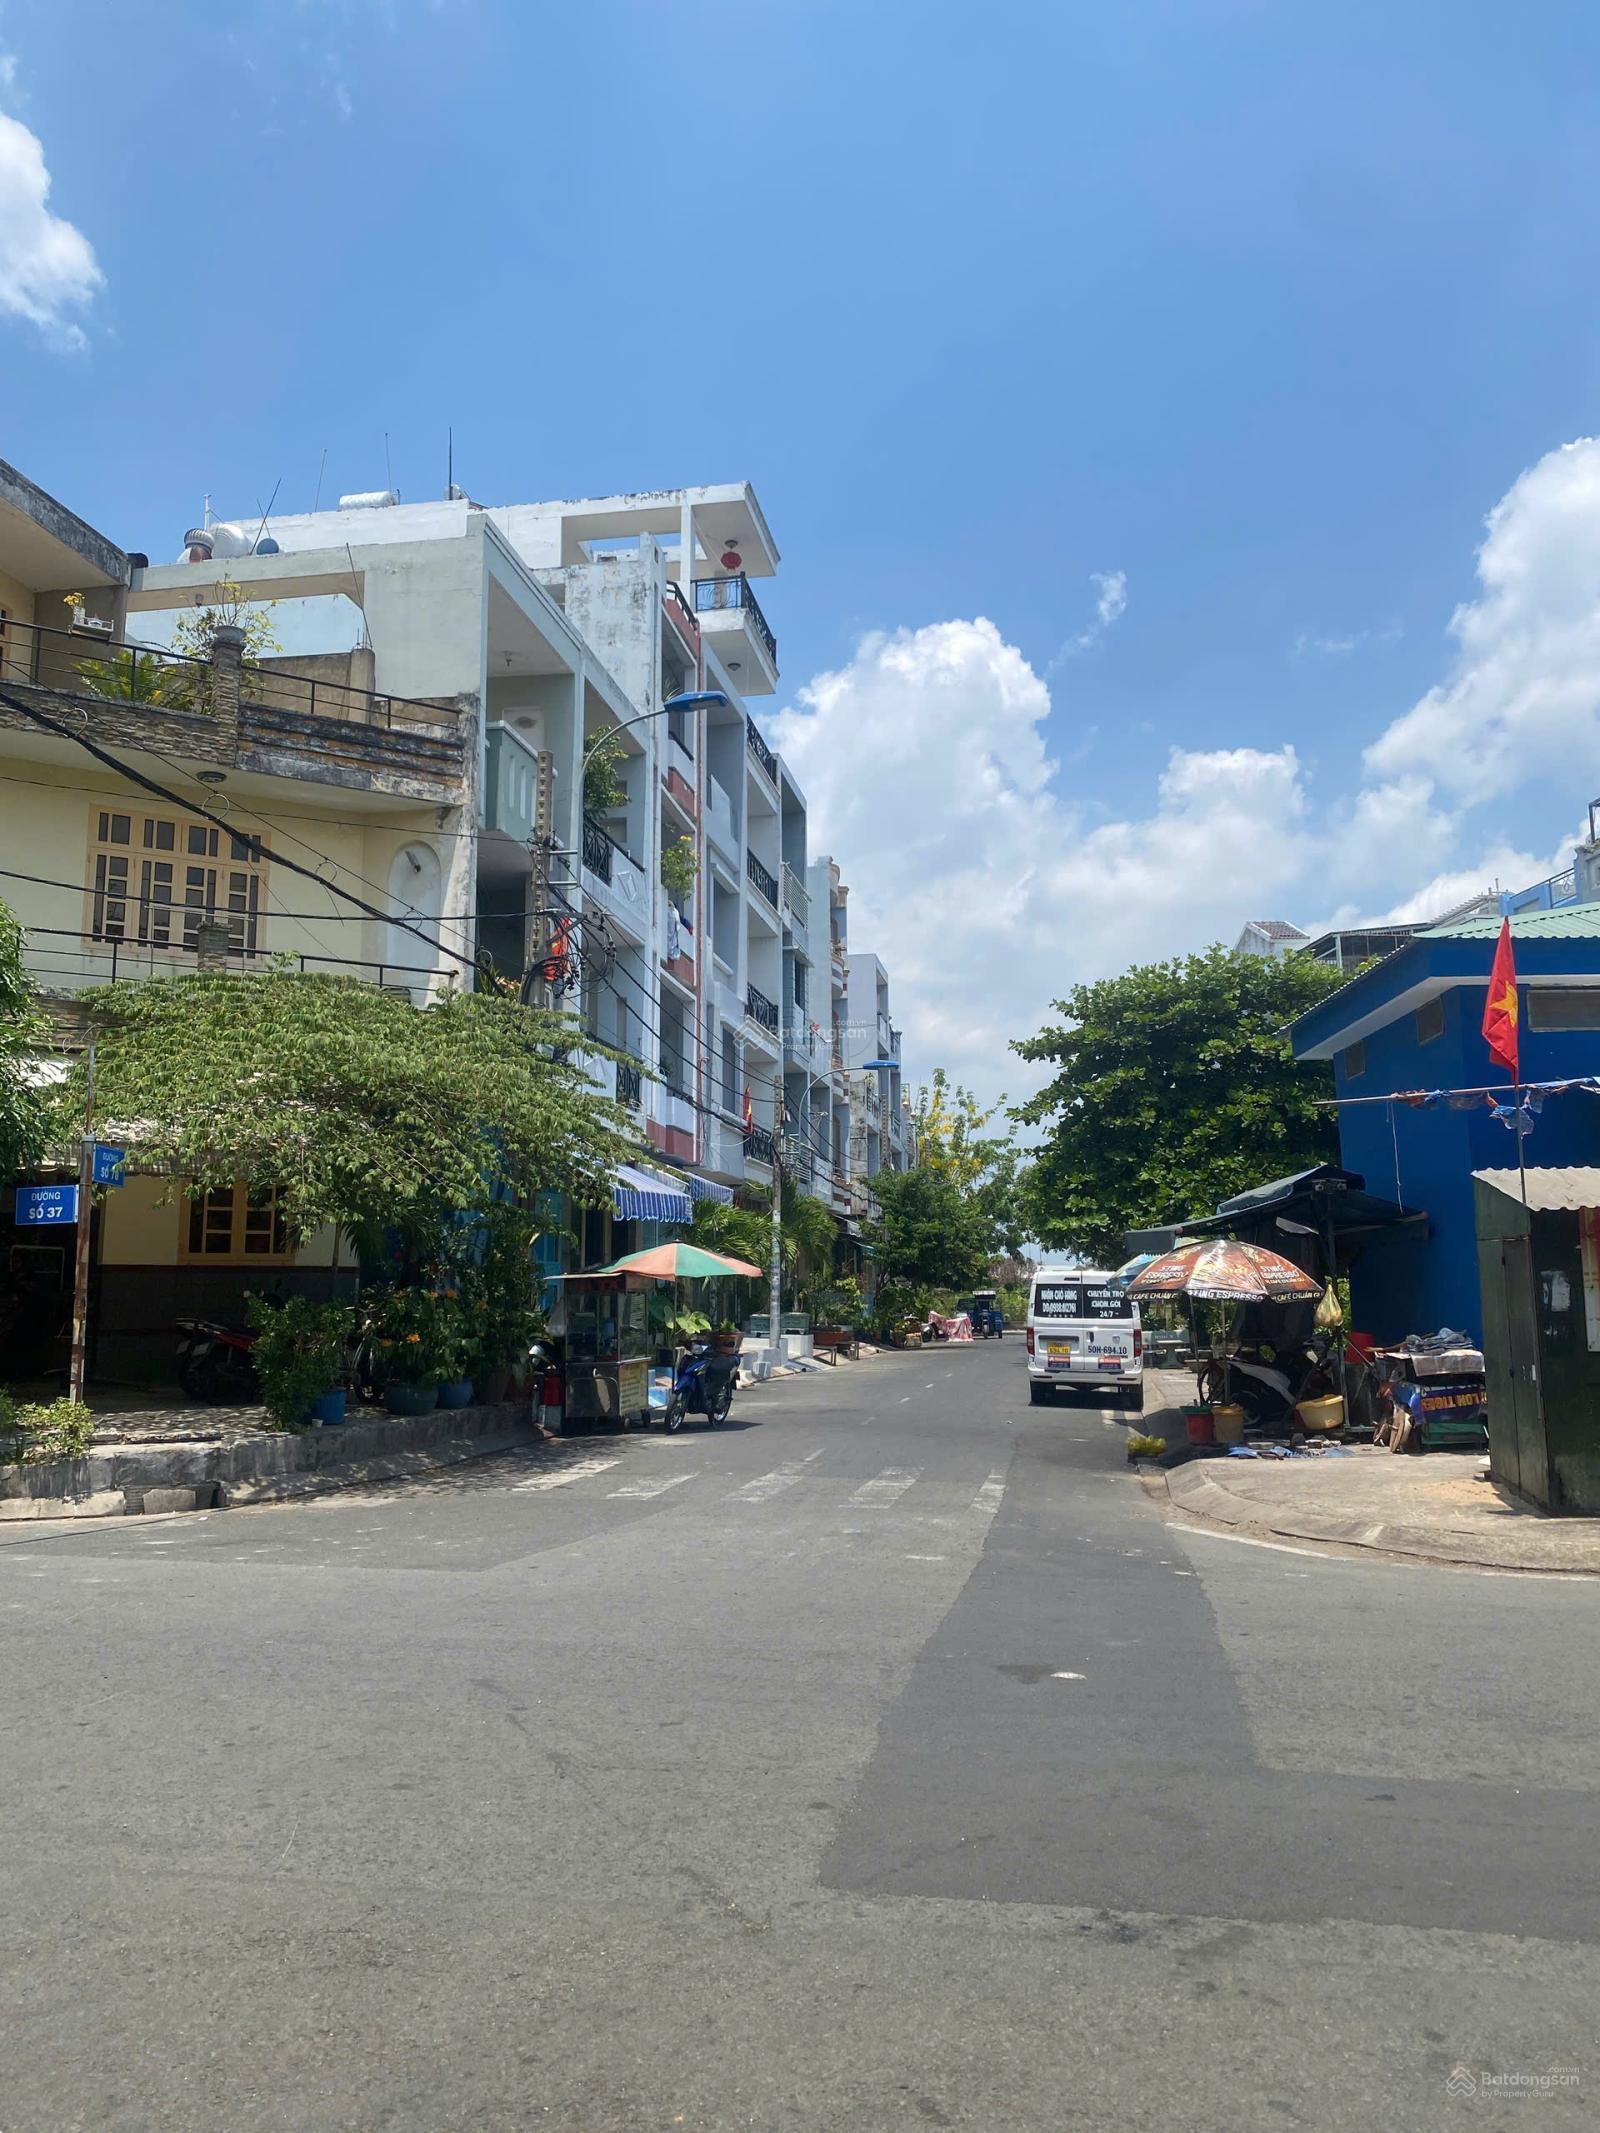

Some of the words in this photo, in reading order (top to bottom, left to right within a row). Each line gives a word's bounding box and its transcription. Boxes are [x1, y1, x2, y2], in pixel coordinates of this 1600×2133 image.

[31, 1191, 61, 1201] ĐƯỜNG
[28, 1203, 44, 1219] SỐ
[46, 1207, 63, 1218] 37
[1217, 1290, 1264, 1302] ESPRESSO
[1087, 1345, 1128, 1354] 50H-694.10
